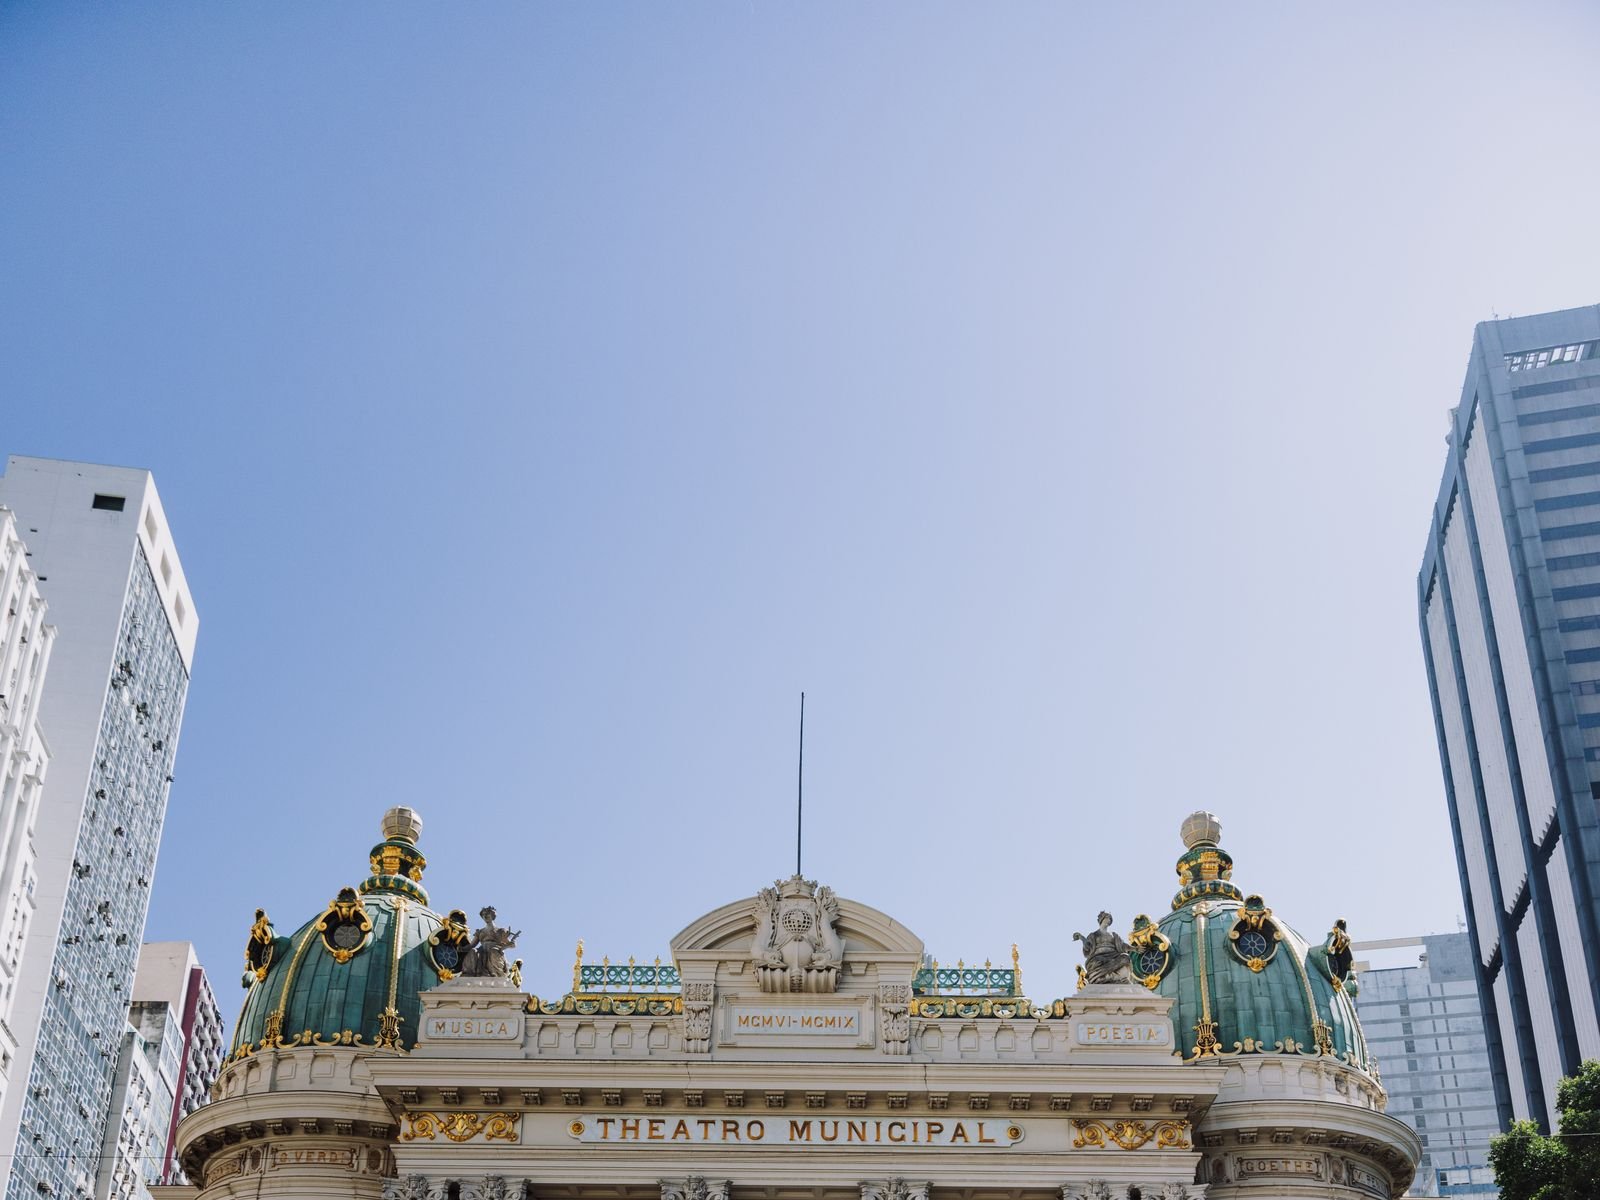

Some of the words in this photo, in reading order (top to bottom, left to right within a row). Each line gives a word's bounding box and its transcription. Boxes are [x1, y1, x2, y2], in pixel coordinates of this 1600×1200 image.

[435, 1021, 507, 1034] MUSICA
[738, 1015, 854, 1028] MCMVI-MCMIX
[1087, 1027, 1157, 1040] POESIA
[597, 1118, 765, 1140] THEATRO
[789, 1120, 995, 1143] MUNICIPAL
[1246, 1160, 1313, 1172] GOETHE
